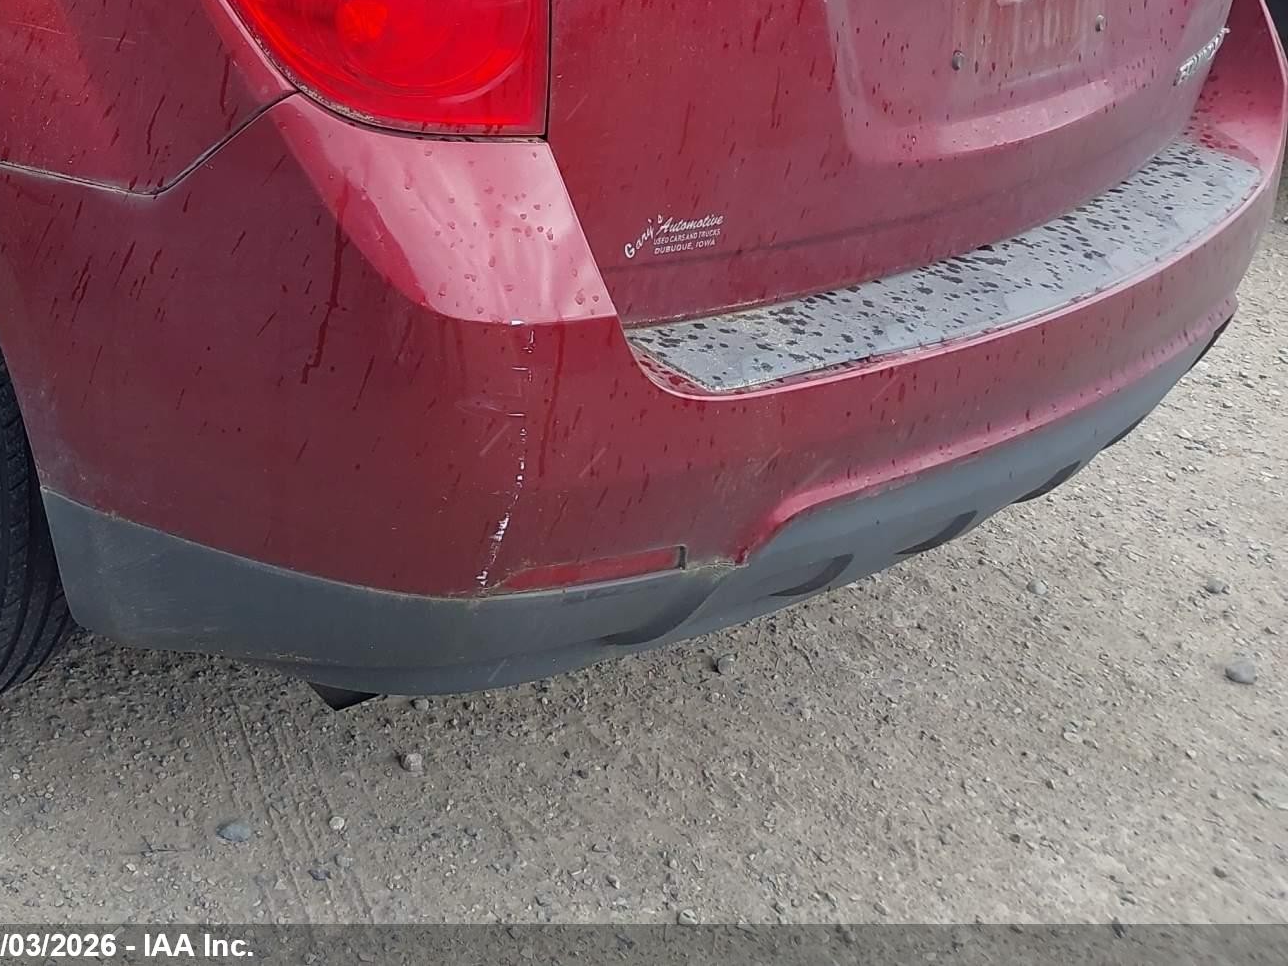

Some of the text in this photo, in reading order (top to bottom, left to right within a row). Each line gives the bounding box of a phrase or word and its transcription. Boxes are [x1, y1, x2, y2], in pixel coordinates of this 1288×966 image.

[655, 214, 724, 236] Automotive
[653, 229, 721, 246] USED CARS AND TRUCKS
[654, 239, 716, 254] DUBUQUE, IOWA
